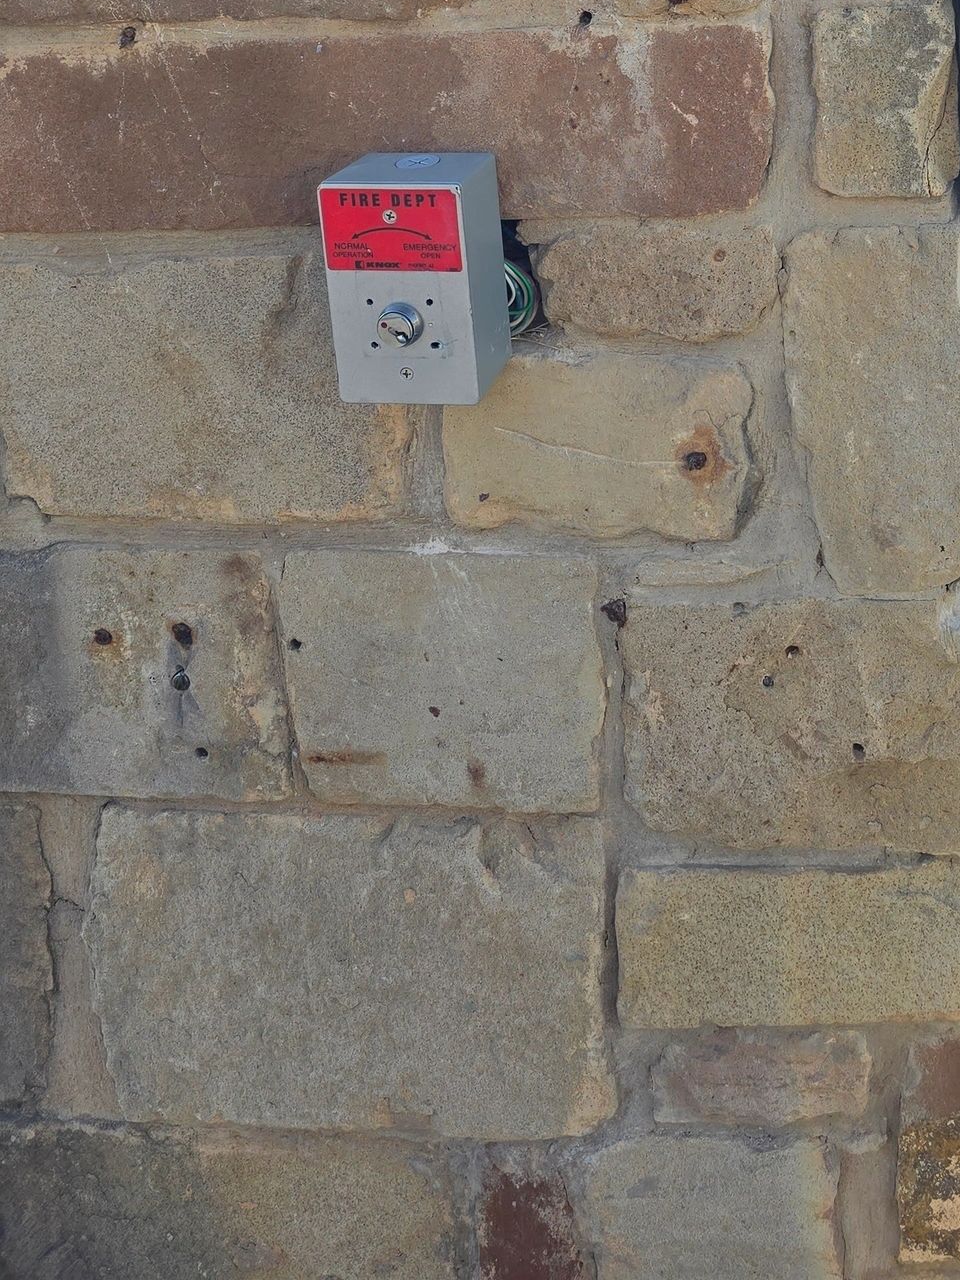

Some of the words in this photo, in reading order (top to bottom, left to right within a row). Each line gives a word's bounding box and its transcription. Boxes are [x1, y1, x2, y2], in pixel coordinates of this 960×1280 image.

[339, 193, 381, 207] FIRE
[391, 194, 437, 208] DEPT
[334, 242, 369, 251] NORMAL
[403, 243, 457, 252] EMERGENCY
[420, 252, 441, 260] OPEN
